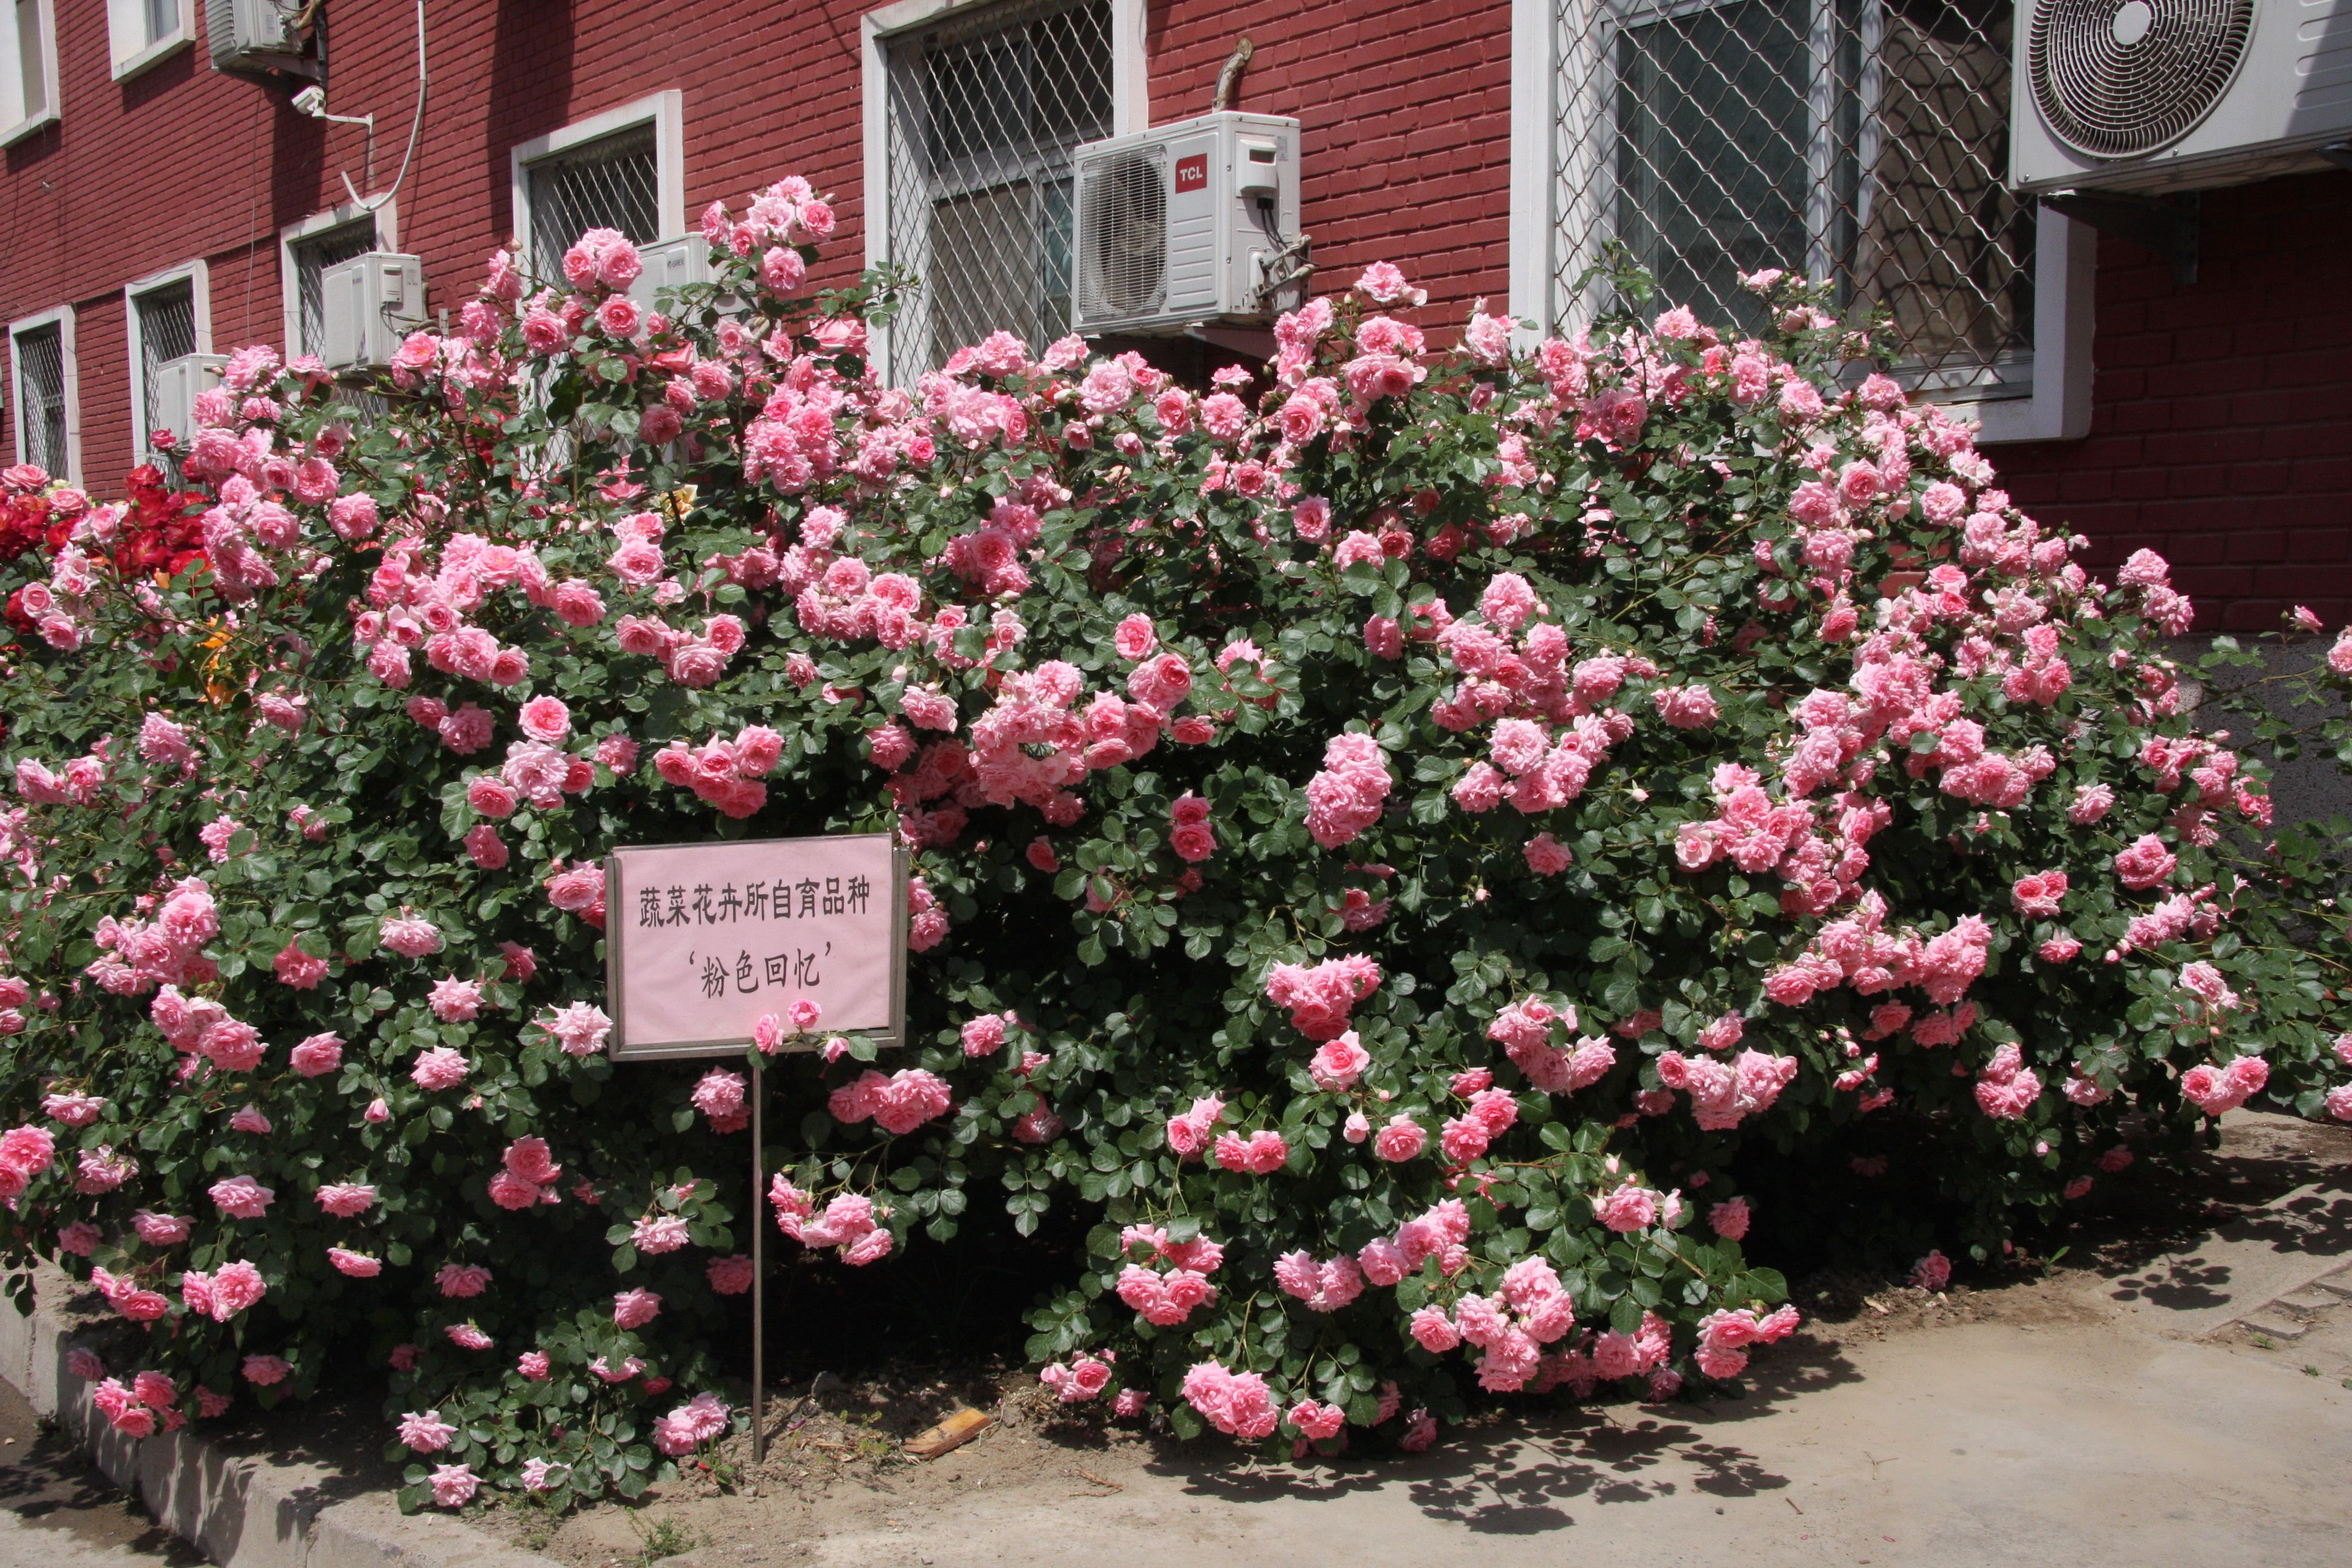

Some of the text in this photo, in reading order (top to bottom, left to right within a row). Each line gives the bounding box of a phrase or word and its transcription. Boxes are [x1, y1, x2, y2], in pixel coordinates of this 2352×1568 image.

[1180, 166, 1203, 181] TCL
[639, 874, 869, 927] 蔬菜花卉所自育品种
